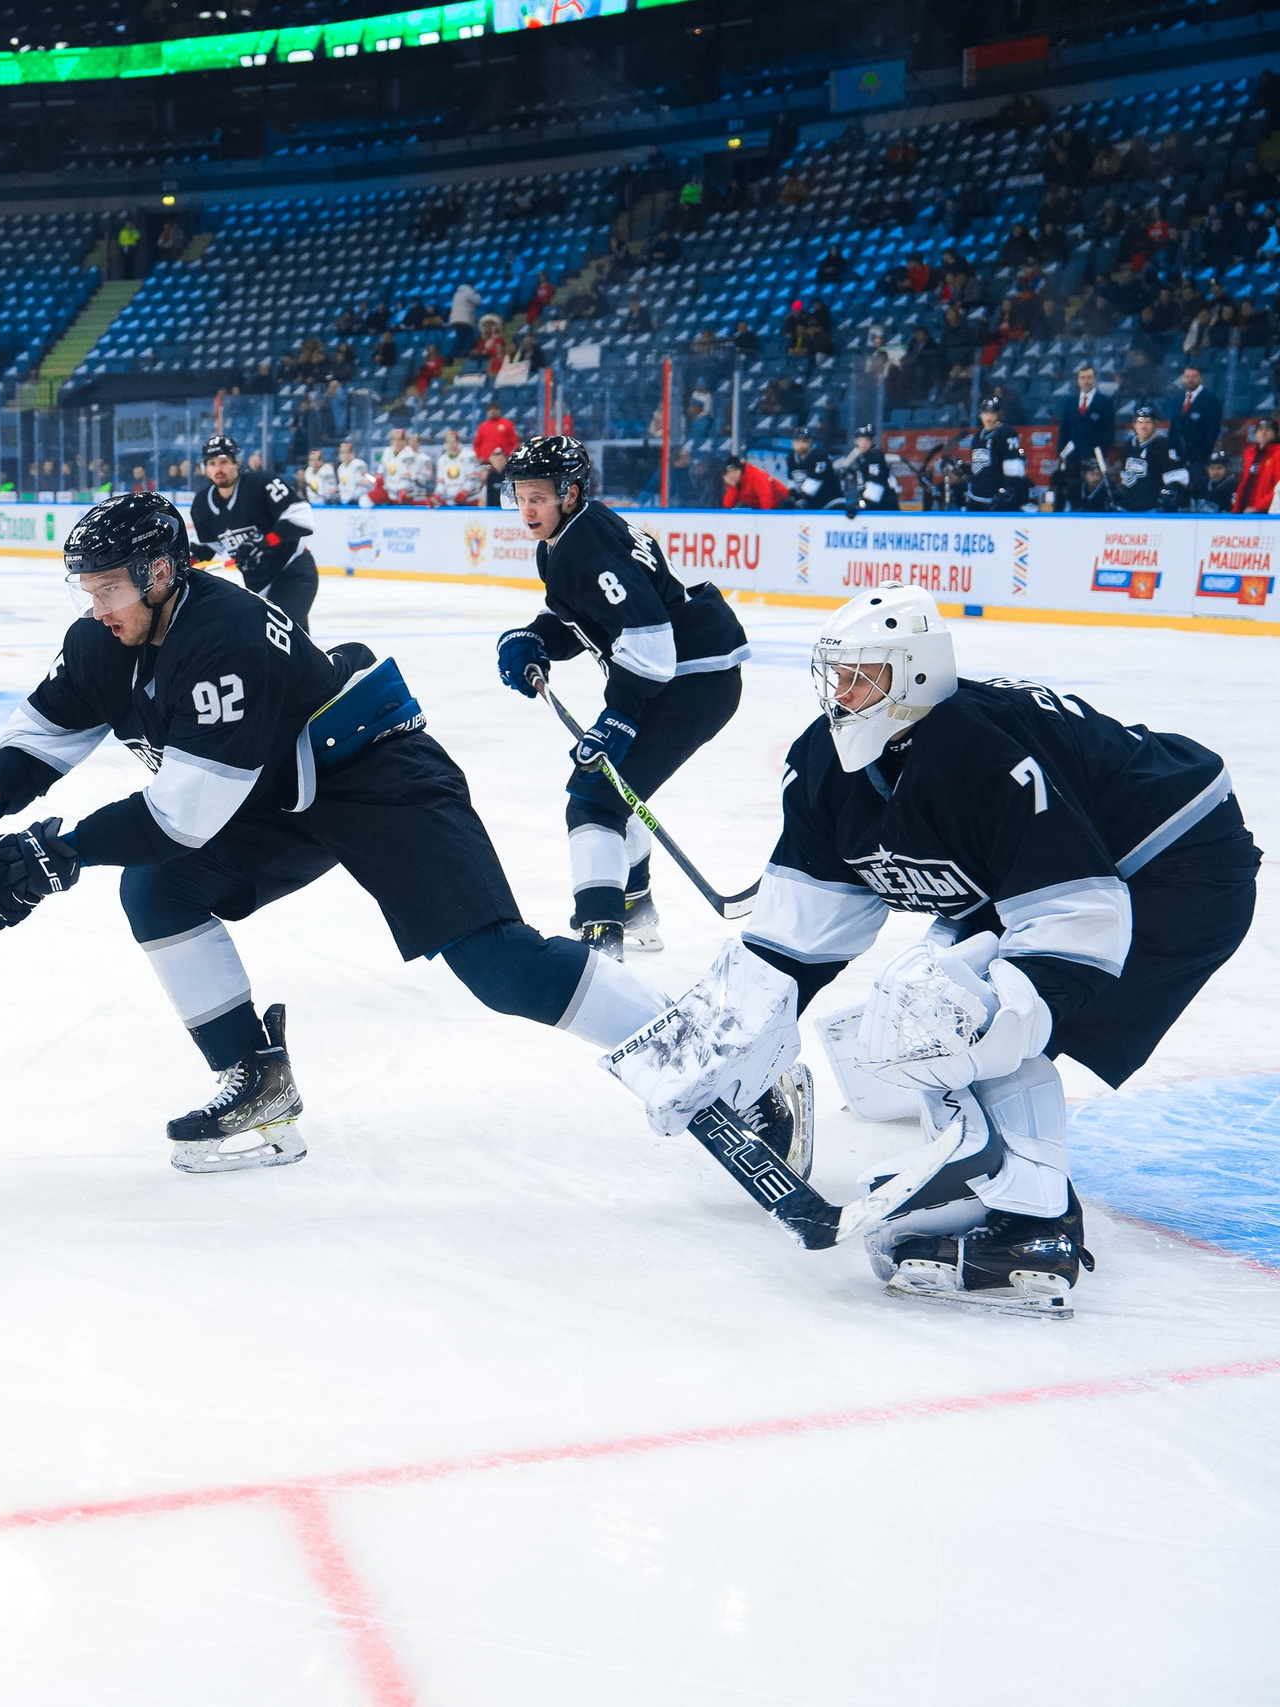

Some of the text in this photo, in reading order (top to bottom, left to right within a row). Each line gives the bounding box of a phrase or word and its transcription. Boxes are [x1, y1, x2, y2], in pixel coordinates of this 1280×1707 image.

[265, 478, 290, 503] 25
[668, 532, 761, 570] FHR.RU
[825, 527, 995, 556] ХОККЕЙ НАЧИНАЕТСЯ ЗДЕСЬ
[1105, 534, 1149, 546] КРАСНАЯ
[1211, 536, 1260, 549] КРАСНАЯ
[1102, 549, 1159, 567] МАШИНА
[1208, 551, 1272, 571] МАШИНА
[598, 571, 627, 605] 8
[266, 600, 294, 655] BU
[498, 631, 545, 651] HERWOOD
[820, 638, 842, 646] CCM
[192, 673, 245, 725] 92
[604, 717, 637, 738] SHER
[1010, 756, 1048, 815] 7
[21, 829, 63, 892] TRUE
[858, 863, 969, 897] ВЁЗДЫ
[611, 1008, 681, 1065] BAUER
[693, 1104, 797, 1203] TRUE
